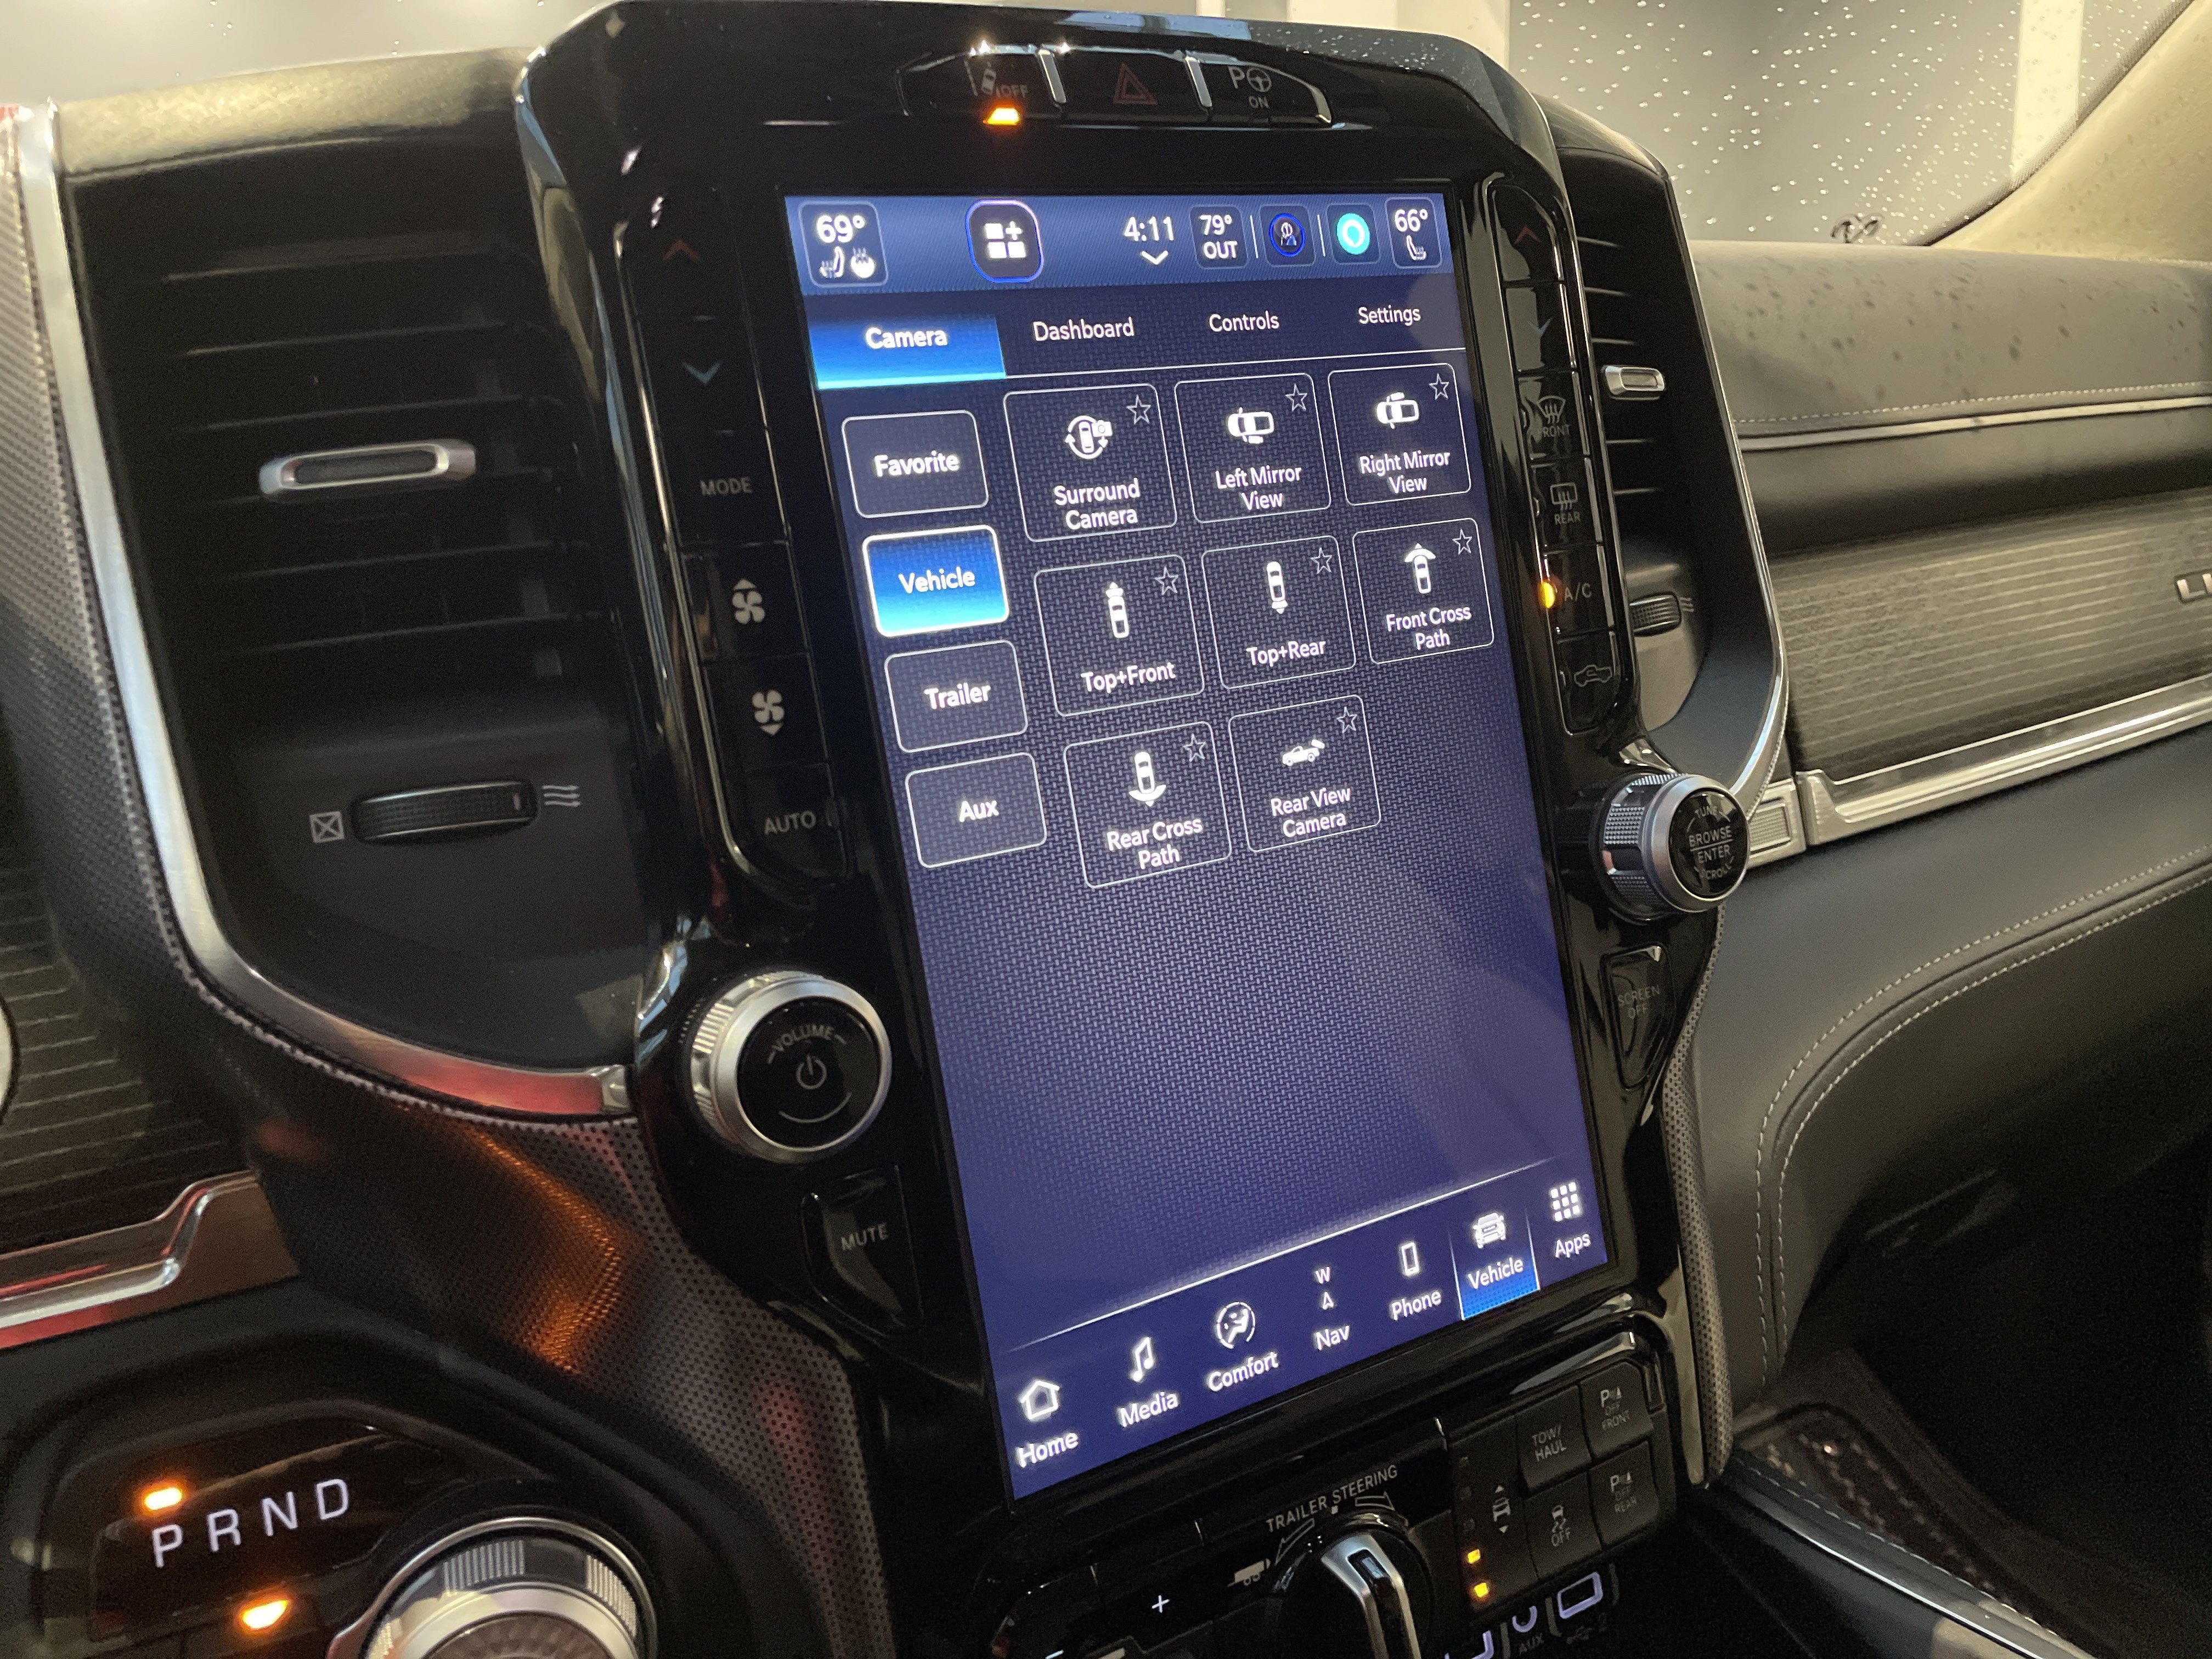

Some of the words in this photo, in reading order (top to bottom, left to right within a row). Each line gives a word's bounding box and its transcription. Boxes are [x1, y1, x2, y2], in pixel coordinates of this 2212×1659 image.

[1228, 65, 1245, 90] P
[1001, 83, 1029, 98] OFF
[1248, 95, 1271, 110] ON
[816, 215, 866, 242] 69°
[1124, 216, 1175, 241] 4:11
[1200, 214, 1232, 236] 79°
[1394, 208, 1429, 233] 66°
[1204, 240, 1238, 259] OUT
[1209, 310, 1280, 332] Controls
[1358, 304, 1421, 327] Settings
[866, 327, 948, 349] Camera
[1032, 317, 1135, 342] Dashboard
[1538, 423, 1571, 438] RONT
[874, 450, 961, 478] Favorite
[1359, 454, 1401, 477] Right
[1403, 450, 1451, 471] Mirror
[700, 477, 753, 495] MODE
[1215, 467, 1249, 490] Left
[1251, 464, 1302, 486] Mirror
[1389, 476, 1427, 494] View
[1054, 477, 1141, 506] Surround
[1242, 492, 1283, 511] View
[1065, 507, 1138, 531] Camera
[1554, 511, 1581, 526] REAR
[898, 566, 976, 594] Vehicle
[1564, 582, 1592, 602] A/C
[1386, 610, 1427, 633] Front
[1430, 605, 1472, 623] Cross
[1415, 628, 1451, 651] Path
[1246, 638, 1327, 668] Top+Rear
[1081, 662, 1176, 695] Top+Front
[924, 681, 991, 710] Trailer
[958, 799, 1000, 822] Aux
[1271, 795, 1310, 816] Rear
[1311, 786, 1352, 809] View
[1694, 805, 1718, 819] TUNE
[764, 810, 817, 835] AUTO
[1107, 827, 1148, 851] Rear
[1152, 818, 1203, 842] Cross
[1283, 811, 1347, 838] Camera
[1689, 825, 1733, 848] BROWSE
[1137, 844, 1180, 870] Path
[1697, 843, 1731, 864] ENTER
[1700, 862, 1732, 881] SCROLL
[1618, 984, 1660, 1005] SCREEN
[1627, 1002, 1649, 1019] OFF
[772, 1024, 834, 1053] VOLUME
[840, 1223, 889, 1251] MUTE
[1555, 1233, 1592, 1259] Apps
[1316, 1266, 1331, 1284] W
[1468, 1257, 1524, 1290] Vehicle
[1392, 1290, 1442, 1321] Phone
[1315, 1324, 1351, 1352] Nav
[1207, 1351, 1279, 1393] Comfort
[1119, 1392, 1179, 1427] Media
[1600, 1389, 1610, 1408] P
[1605, 1402, 1621, 1416] OFF
[1602, 1409, 1631, 1431] FRONT
[1532, 1425, 1562, 1447] TOW/
[1016, 1431, 1079, 1469] Home
[1534, 1439, 1567, 1462] HAUL
[1610, 1474, 1620, 1493] P
[1266, 1492, 1328, 1534] TRAILER
[1331, 1464, 1399, 1505] STEERING
[1615, 1496, 1638, 1515] REAR
[151, 1522, 183, 1569] P
[206, 1508, 242, 1552] R
[261, 1490, 300, 1537] N
[315, 1477, 351, 1521] D
[1551, 1527, 1571, 1547] OFF
